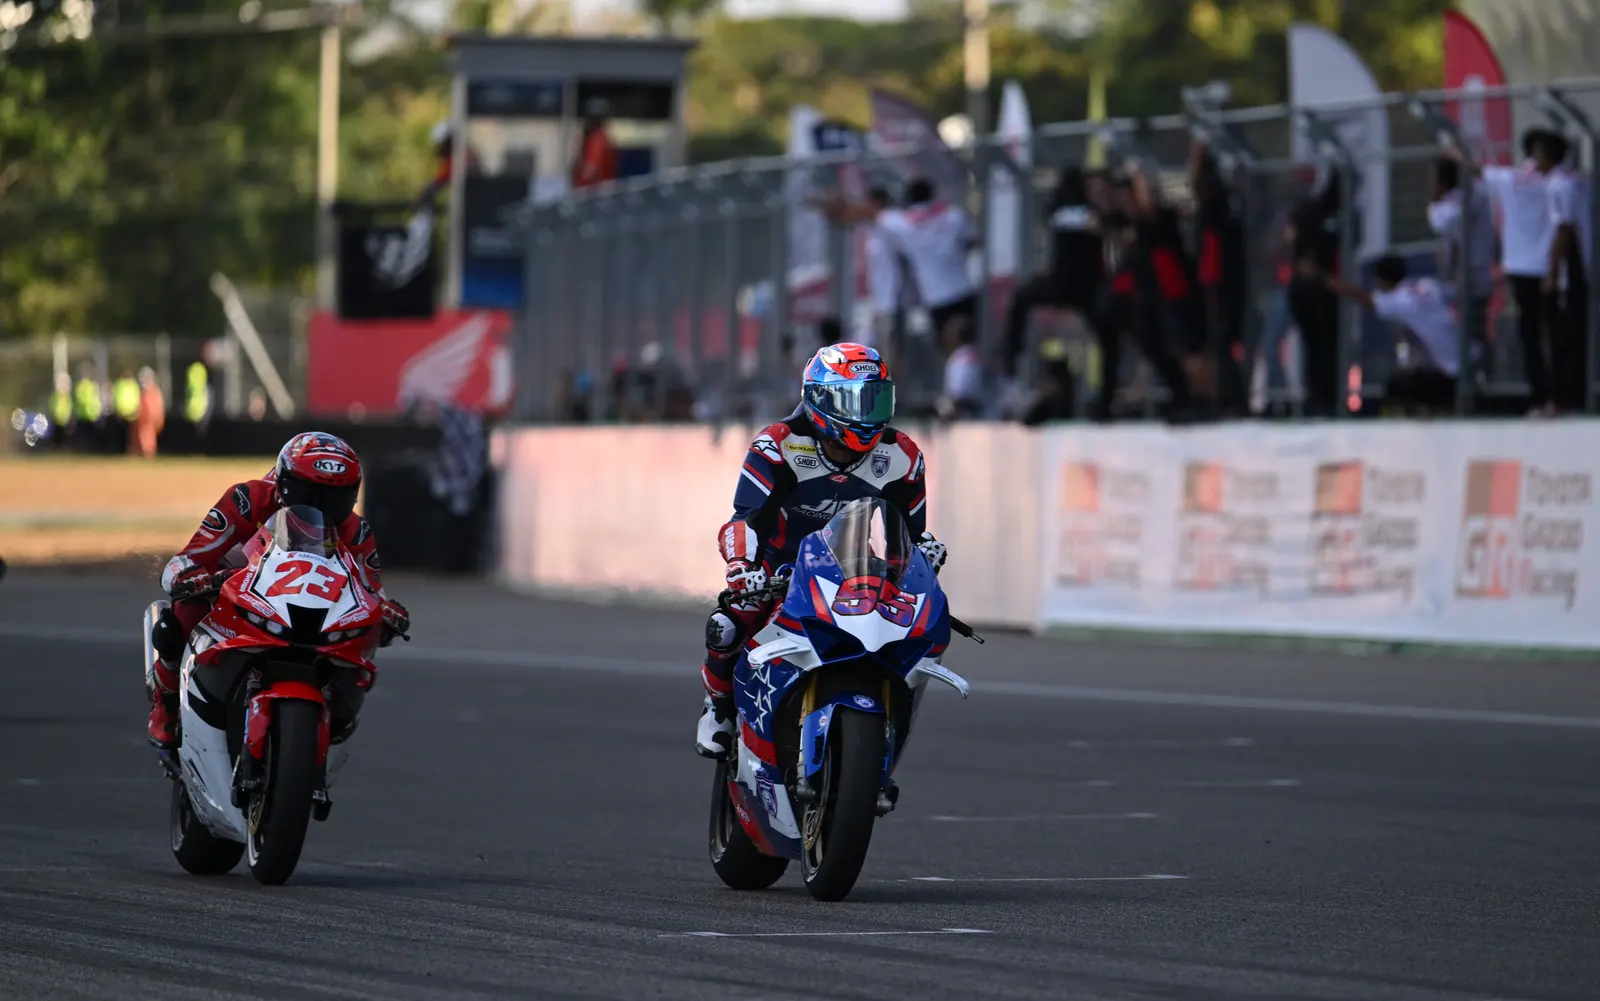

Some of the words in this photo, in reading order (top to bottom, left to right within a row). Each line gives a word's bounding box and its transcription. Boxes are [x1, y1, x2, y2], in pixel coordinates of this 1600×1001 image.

[854, 364, 877, 372] SHOEI
[789, 444, 817, 453] DUNLOP
[317, 460, 345, 472] KYT
[797, 457, 817, 467] SHOEI
[265, 560, 349, 603] 23
[832, 575, 918, 629] 55
